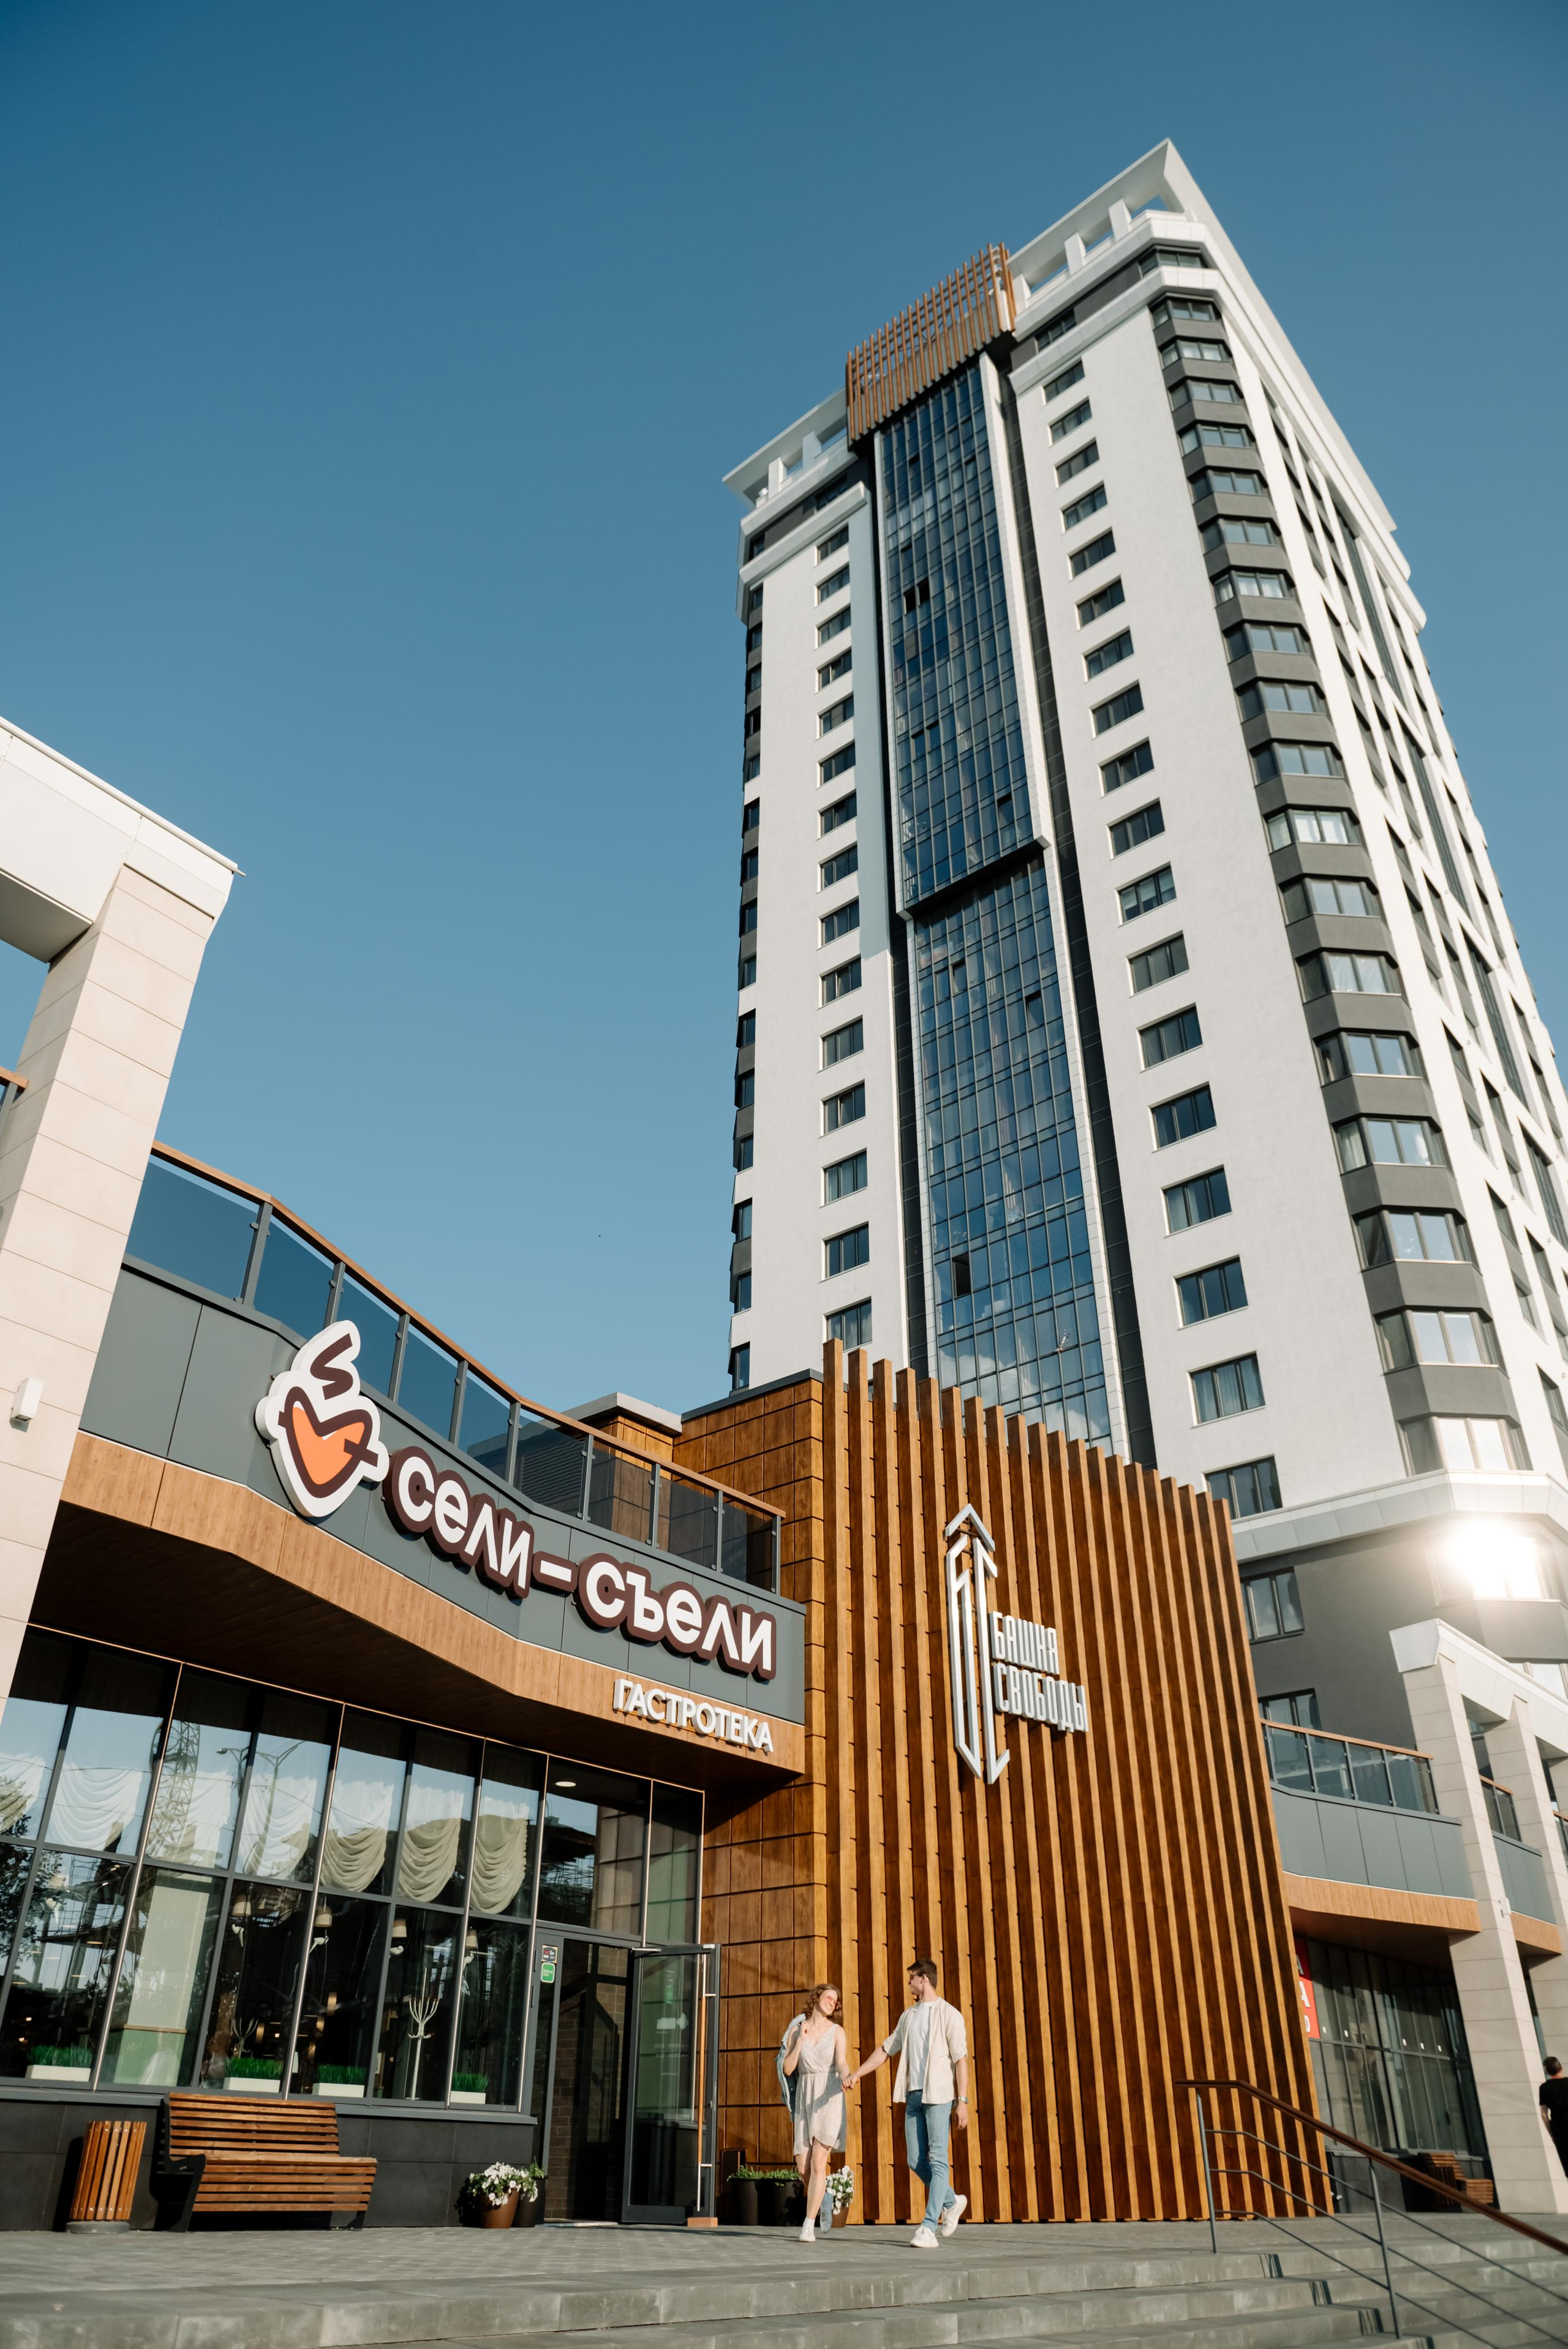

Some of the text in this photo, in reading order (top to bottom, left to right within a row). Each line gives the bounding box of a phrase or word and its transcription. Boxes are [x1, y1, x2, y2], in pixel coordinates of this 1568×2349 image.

[990, 1611, 1060, 1674] БАШНЯ
[613, 1679, 774, 1752] ГАСТРОТЕКА
[993, 1662, 1088, 1733] СВОБОДЫ
